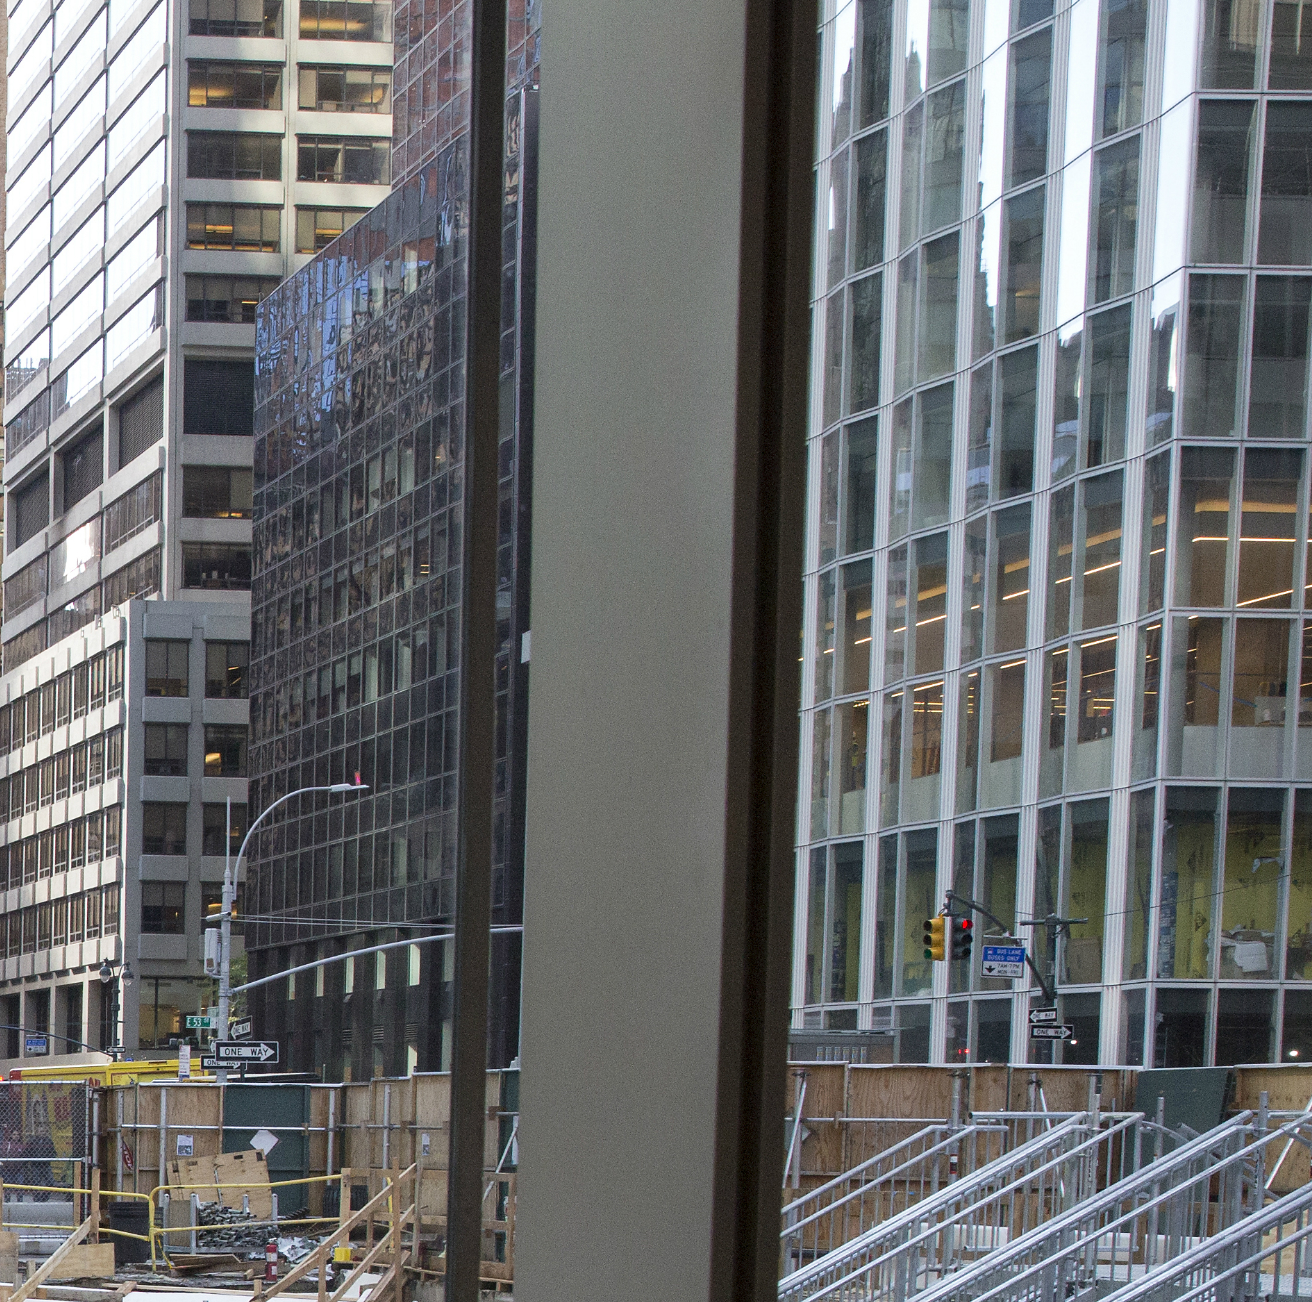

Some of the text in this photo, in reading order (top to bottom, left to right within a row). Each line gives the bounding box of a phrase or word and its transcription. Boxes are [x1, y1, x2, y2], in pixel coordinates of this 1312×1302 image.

[187, 1018, 192, 1027] E
[193, 1018, 202, 1027] 53
[224, 1047, 270, 1057] ONE WAY
